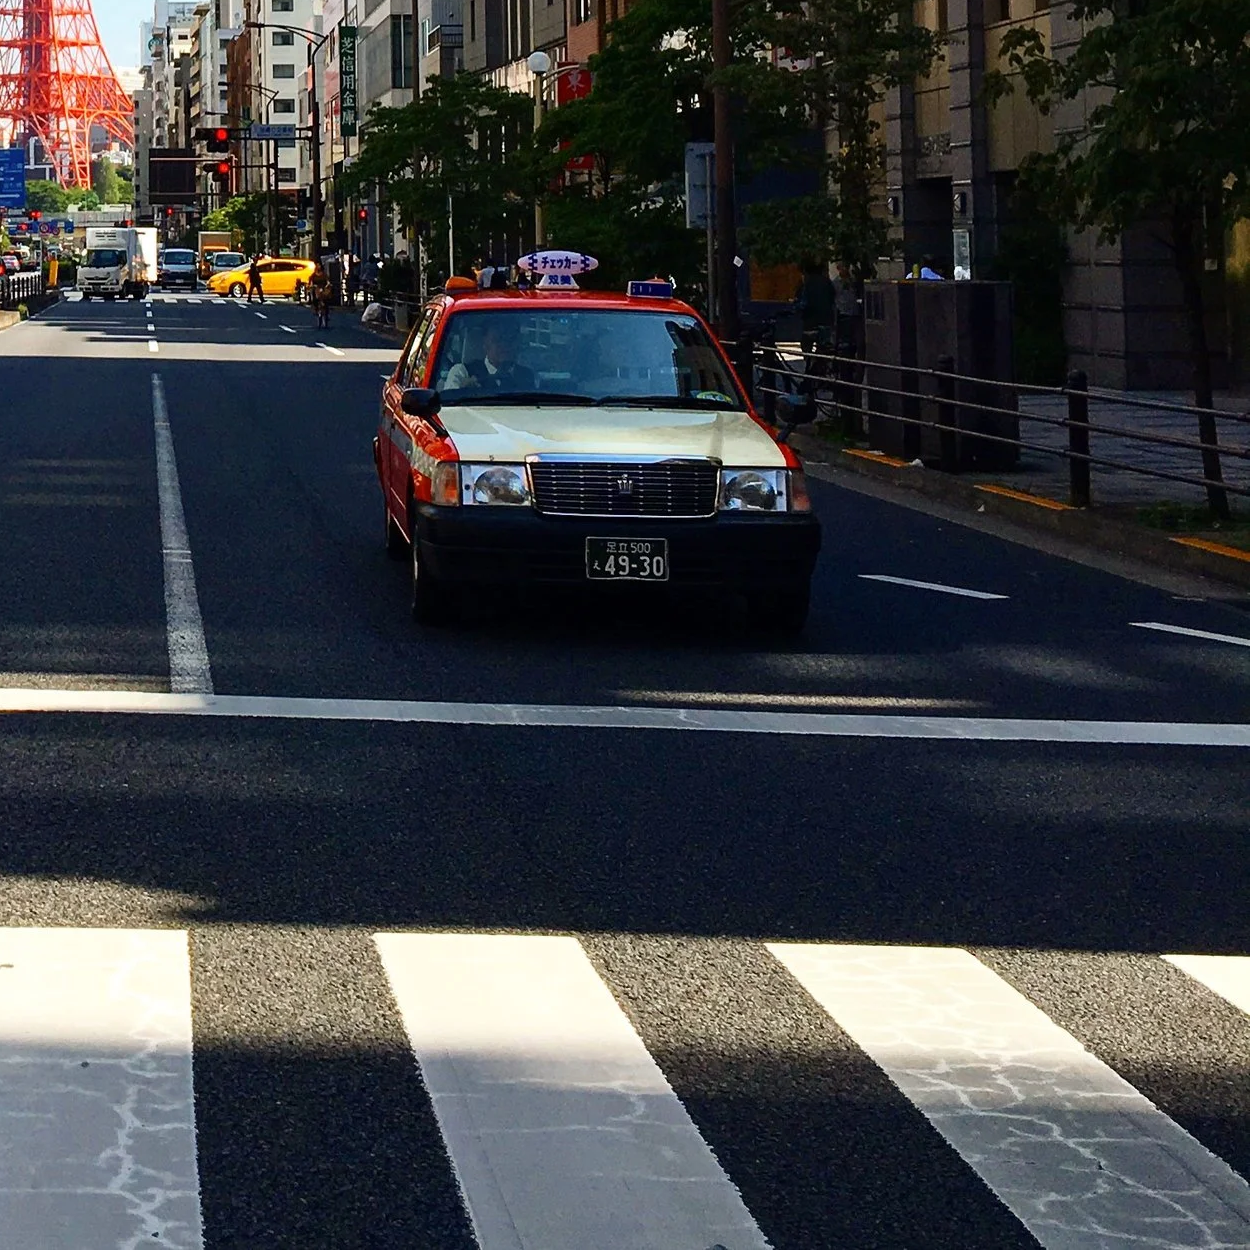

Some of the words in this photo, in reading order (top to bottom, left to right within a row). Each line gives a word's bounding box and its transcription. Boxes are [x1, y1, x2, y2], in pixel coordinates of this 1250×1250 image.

[341, 37, 356, 126] 芝信用金庫
[541, 255, 578, 269] チェッカー
[606, 541, 629, 553] 足立
[630, 542, 651, 554] 500
[604, 554, 664, 577] 49-30
